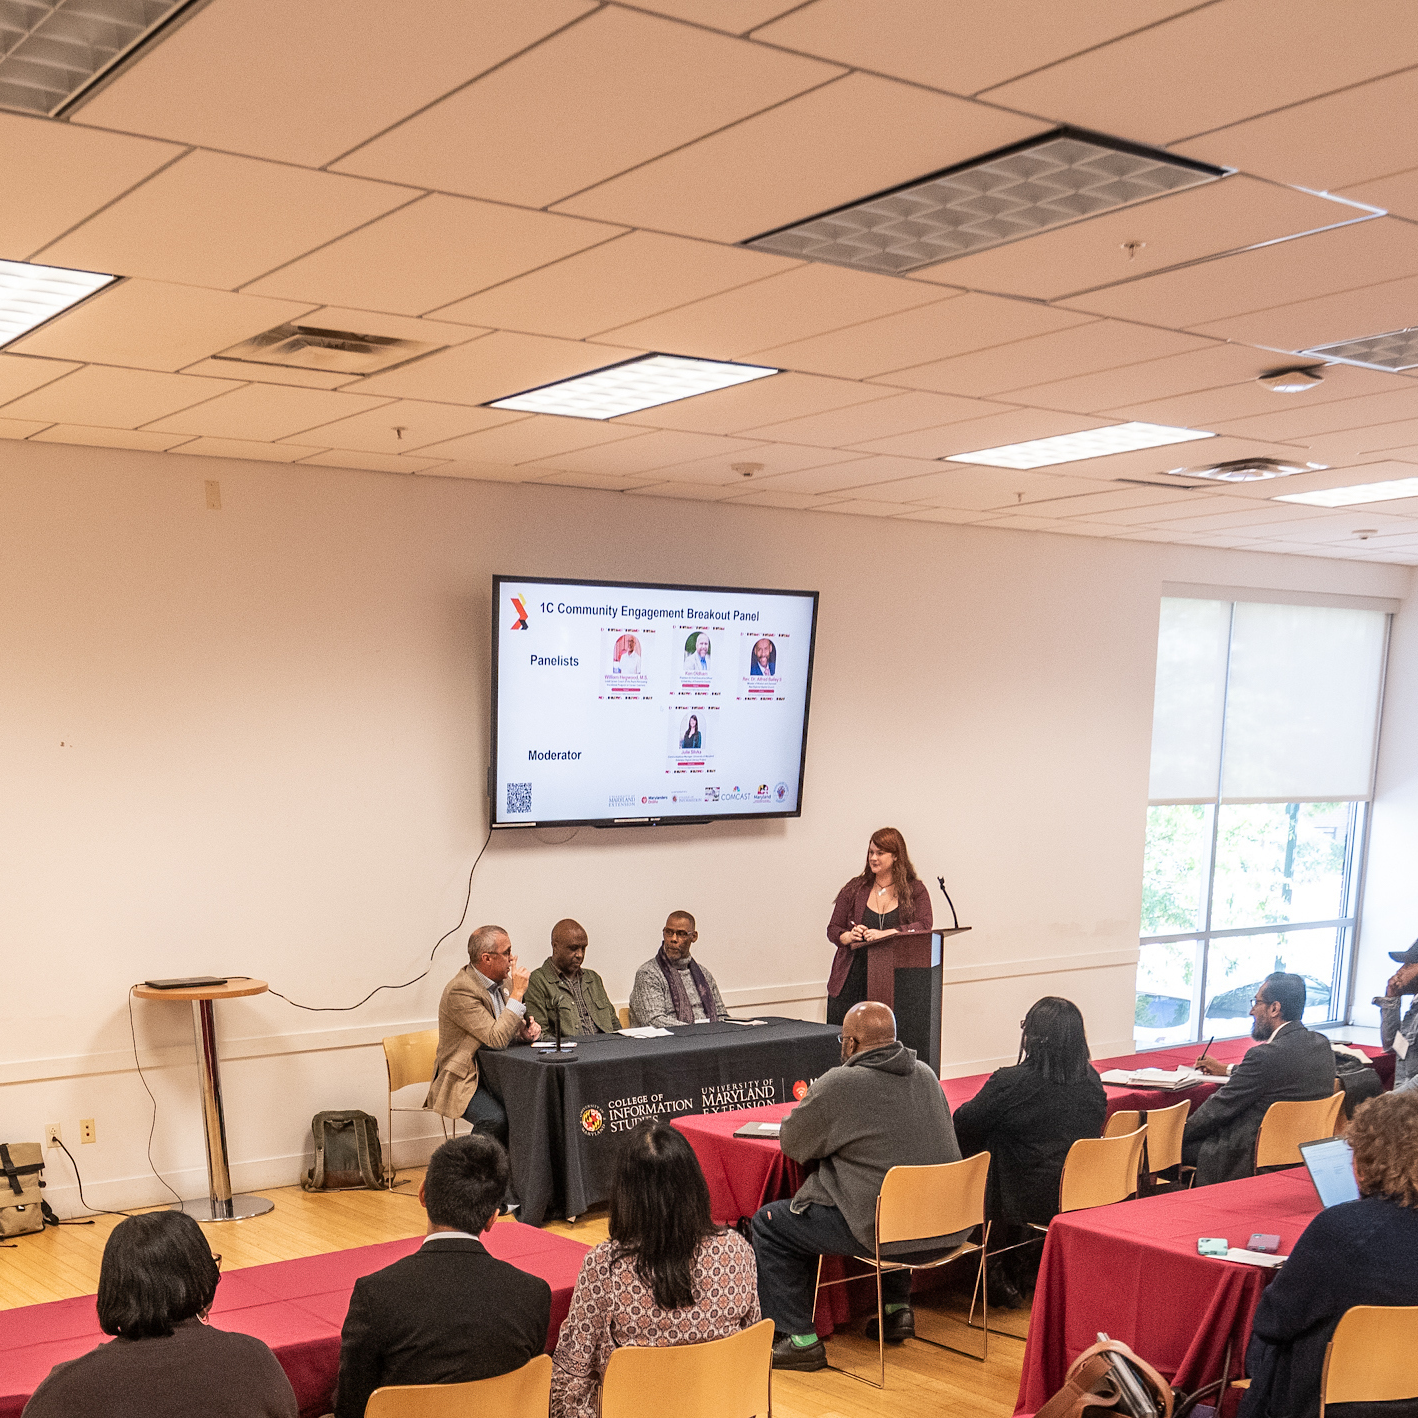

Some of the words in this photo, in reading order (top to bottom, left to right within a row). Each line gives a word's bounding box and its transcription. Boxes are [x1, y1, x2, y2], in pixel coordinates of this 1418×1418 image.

[540, 602, 554, 614] 1C
[557, 603, 618, 618] Community
[621, 605, 684, 620] Engagement
[687, 608, 730, 620] Breakout
[733, 610, 759, 621] Panel
[530, 655, 579, 666] Panelists
[528, 750, 582, 760] Moderator
[721, 793, 751, 801] COMCAST
[701, 1080, 760, 1095] UNIVERSITY
[763, 1078, 774, 1086] OF
[608, 1095, 648, 1109] COLLEGE
[651, 1093, 664, 1102] OF
[701, 1085, 775, 1108] MARYLAND
[609, 1098, 693, 1121] INFORMATION
